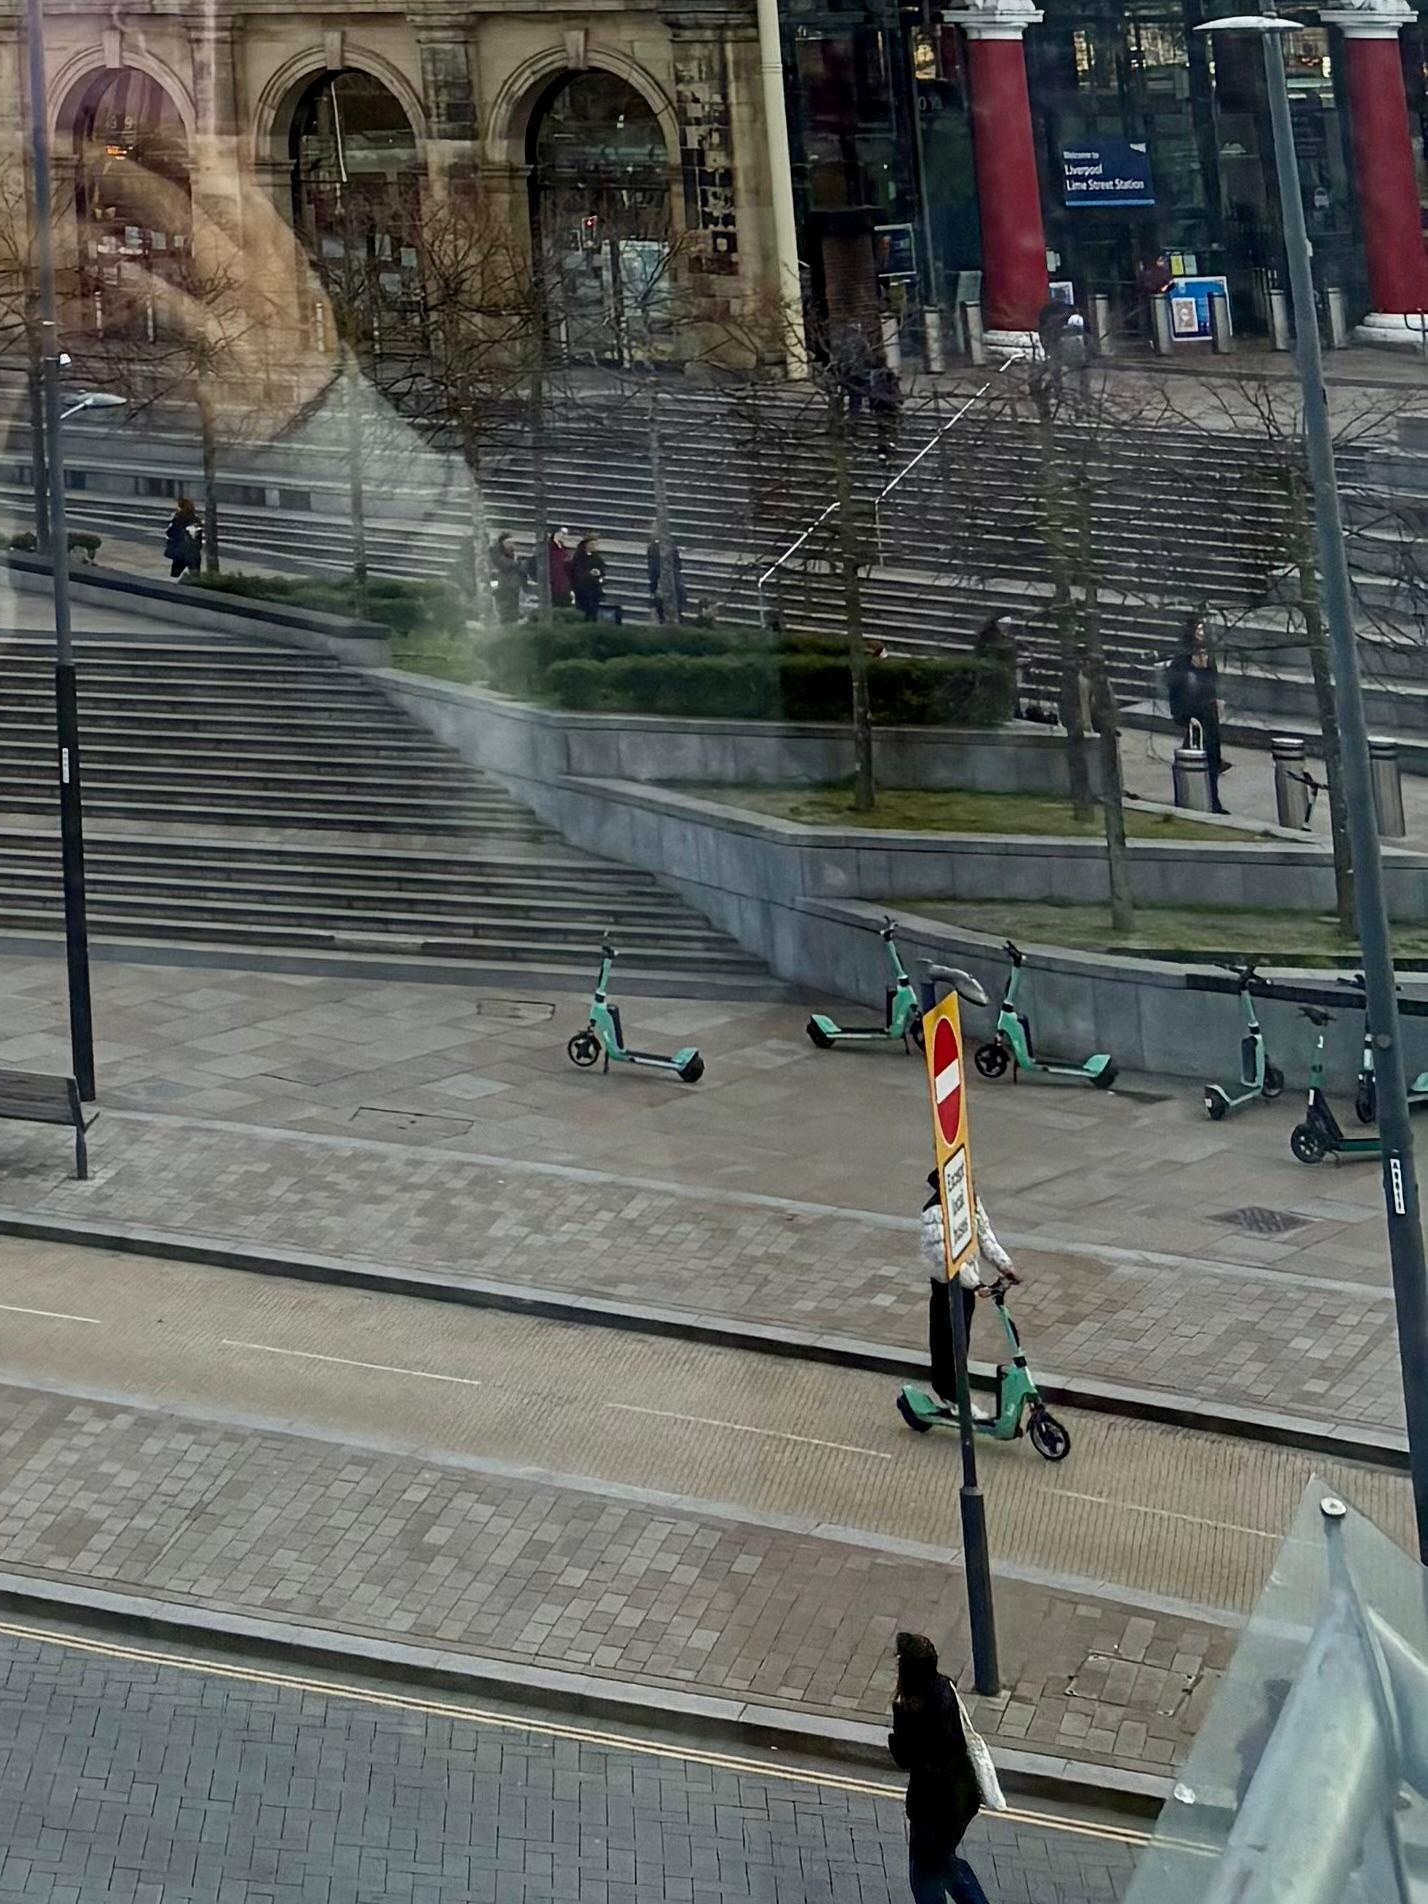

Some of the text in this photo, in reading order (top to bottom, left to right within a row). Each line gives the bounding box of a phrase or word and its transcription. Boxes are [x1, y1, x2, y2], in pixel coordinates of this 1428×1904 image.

[1064, 163, 1103, 177] Liverpool
[1066, 178, 1145, 191] Lime Street Station
